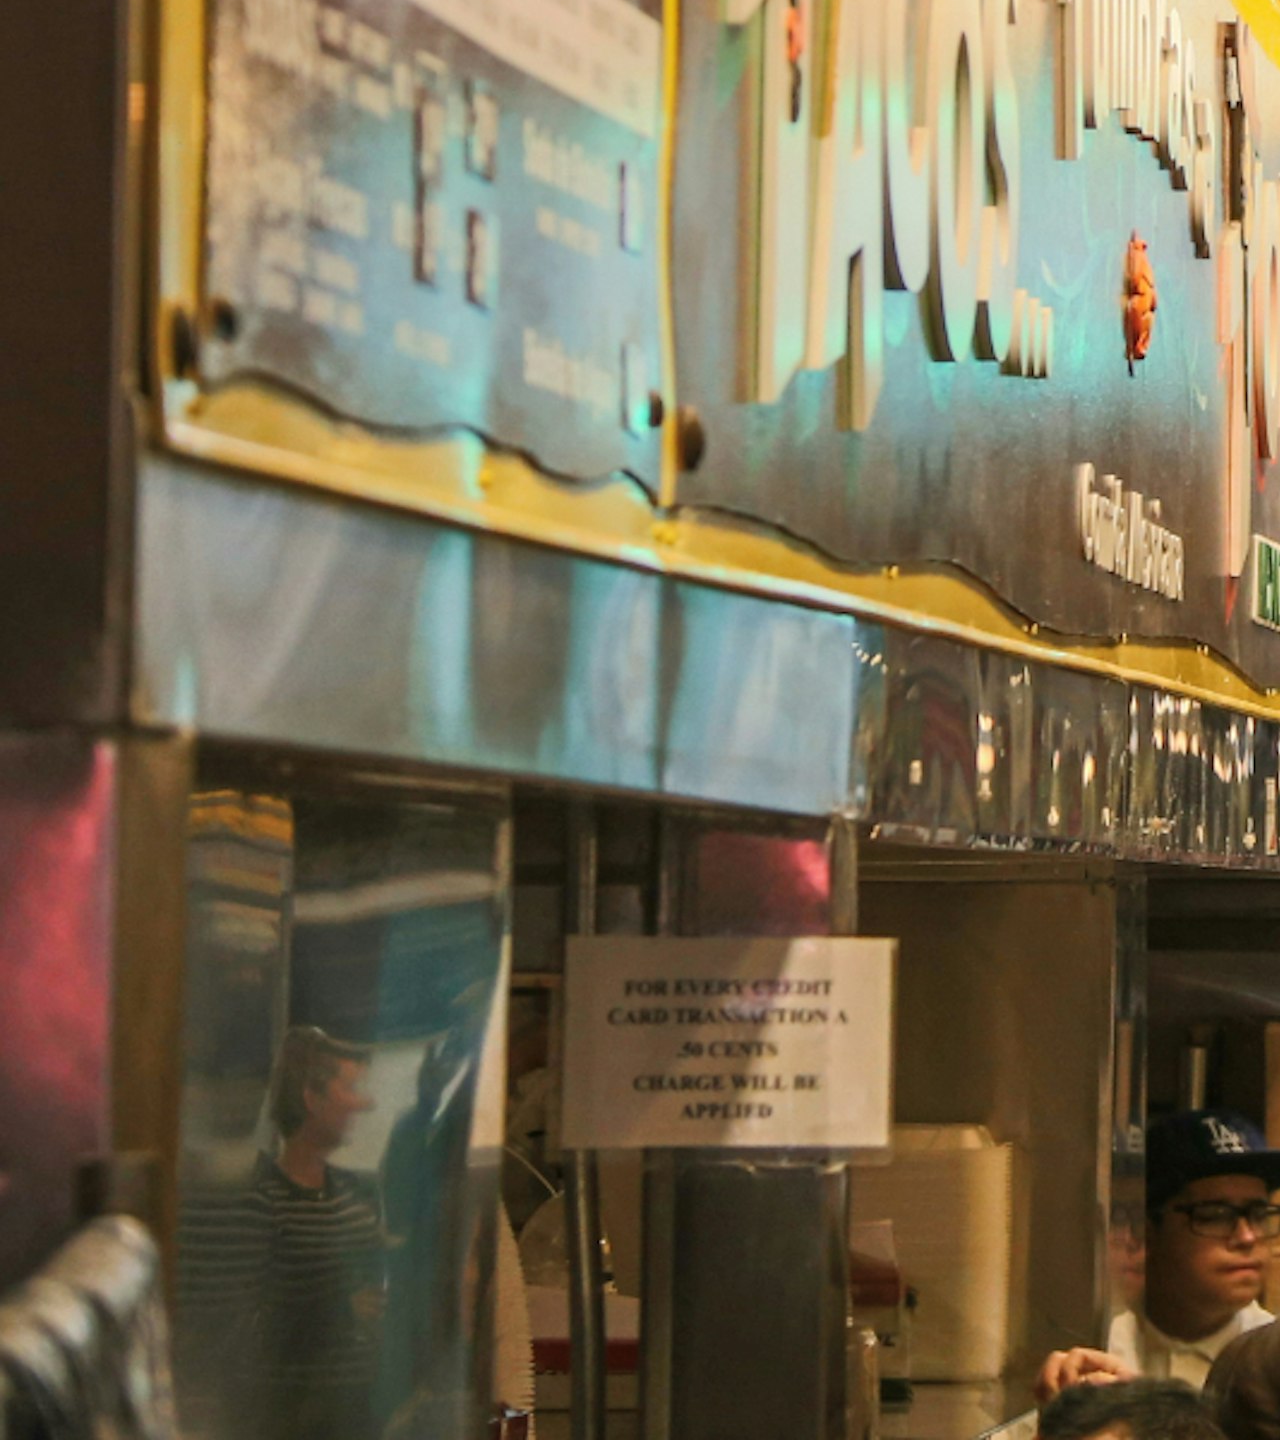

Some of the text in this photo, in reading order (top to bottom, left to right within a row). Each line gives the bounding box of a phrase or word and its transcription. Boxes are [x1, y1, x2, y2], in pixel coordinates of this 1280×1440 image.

[624, 979, 833, 997] FOR EVERY CREDIT
[607, 1008, 849, 1026] CARD TRANSACTION A
[708, 1041, 779, 1059] CENTS
[632, 1074, 821, 1092] CHARGE WILL BE
[681, 1102, 774, 1120] APPLIED
